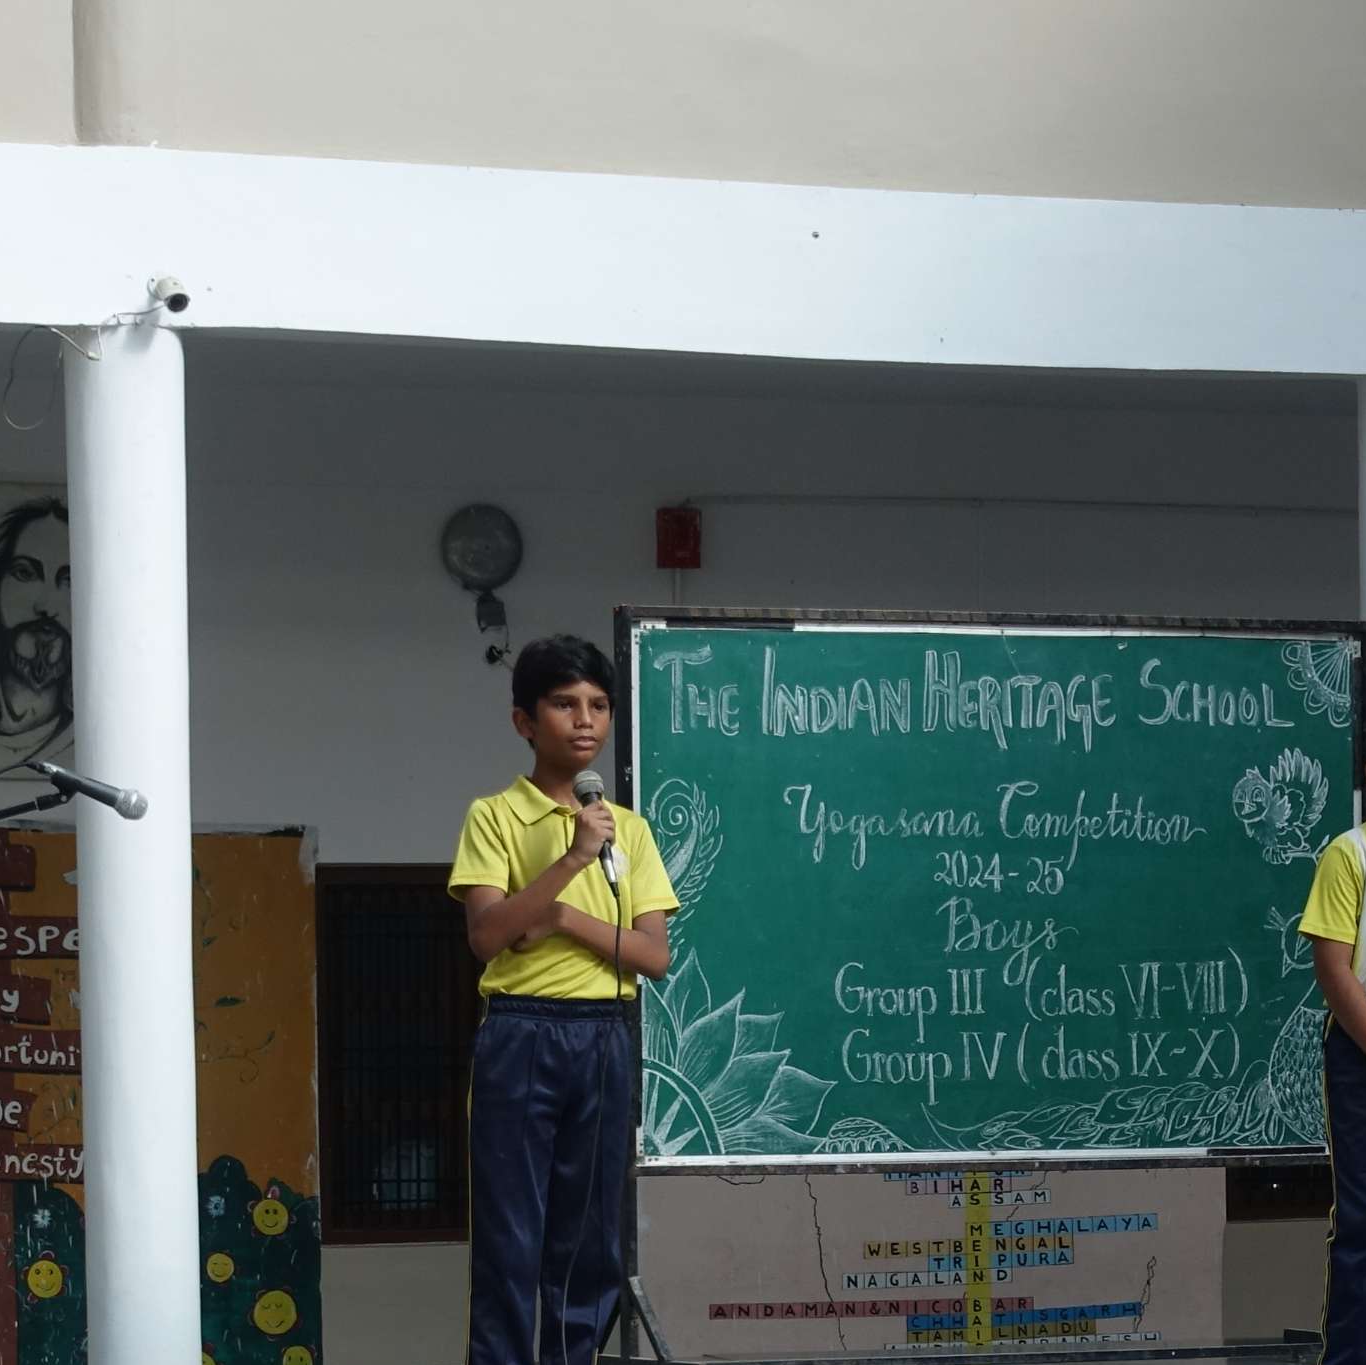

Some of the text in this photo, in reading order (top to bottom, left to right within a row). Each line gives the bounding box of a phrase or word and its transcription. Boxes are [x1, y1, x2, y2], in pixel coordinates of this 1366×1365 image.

[653, 645, 1295, 752] THE INDIAN HERITAGE SCHOOL
[783, 780, 1208, 871] Yogasana Competition
[935, 895, 1080, 986] Boys
[834, 961, 937, 1044] Group
[946, 967, 989, 1017] III
[840, 1028, 953, 1106] Group
[960, 1031, 1009, 1082] IV
[910, 1178, 1004, 1194] BIHAR
[951, 1191, 1048, 1208] ASSAM
[970, 1217, 1153, 1237] MEGHALAYA
[846, 1269, 1009, 1290] NAGALAND
[933, 1251, 1072, 1270] TRIPURA
